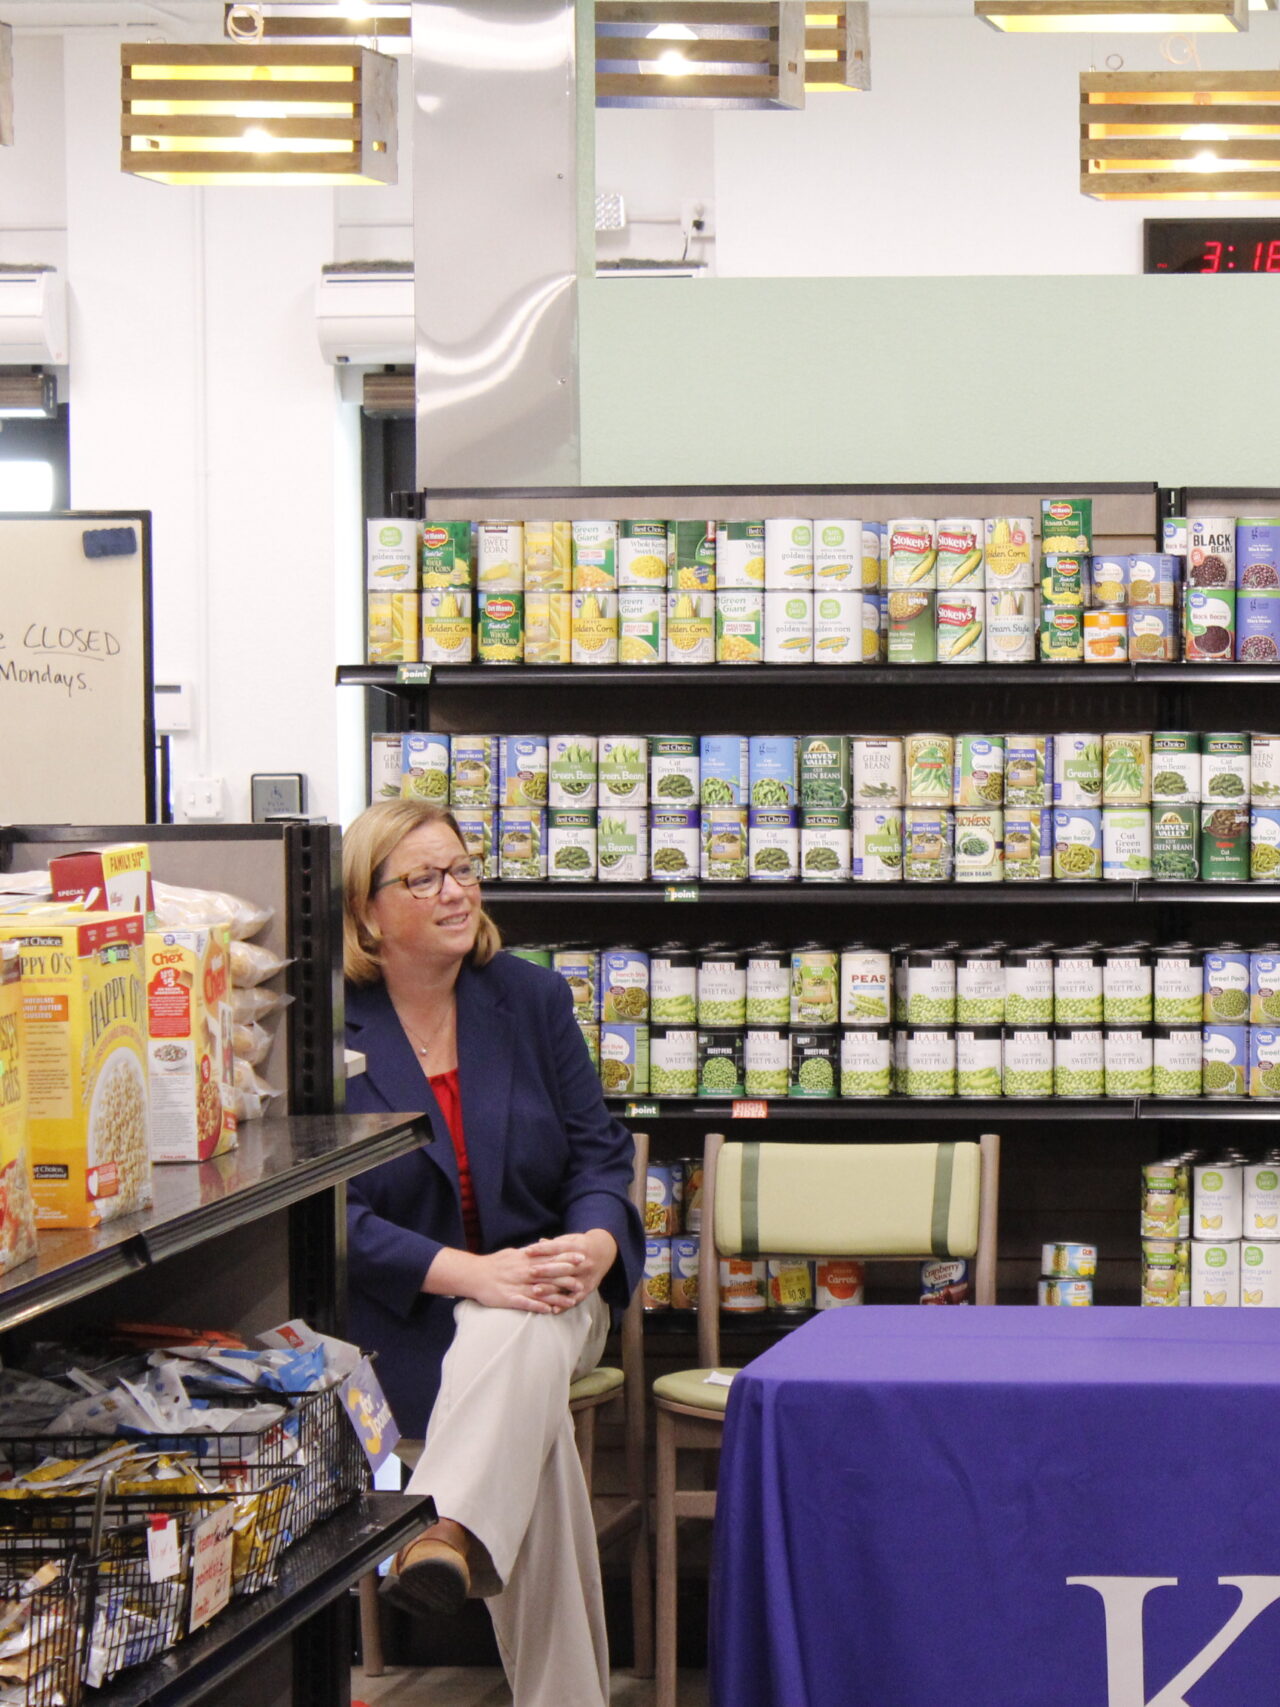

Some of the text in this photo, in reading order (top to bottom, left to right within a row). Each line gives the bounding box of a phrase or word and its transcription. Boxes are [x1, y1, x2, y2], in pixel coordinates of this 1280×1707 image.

[893, 535, 930, 548] Stokely's
[1193, 534, 1231, 547] BLACK
[23, 623, 121, 656] CLOSED
[402, 669, 427, 679] point
[1119, 832, 1136, 840] Cut
[1115, 840, 1141, 848] Green
[110, 853, 131, 873] FAMILY
[57, 888, 85, 897] SPECIAL
[672, 889, 695, 899] point
[152, 953, 184, 966] Chex
[851, 974, 887, 983] PEAS
[631, 1106, 656, 1116] point
